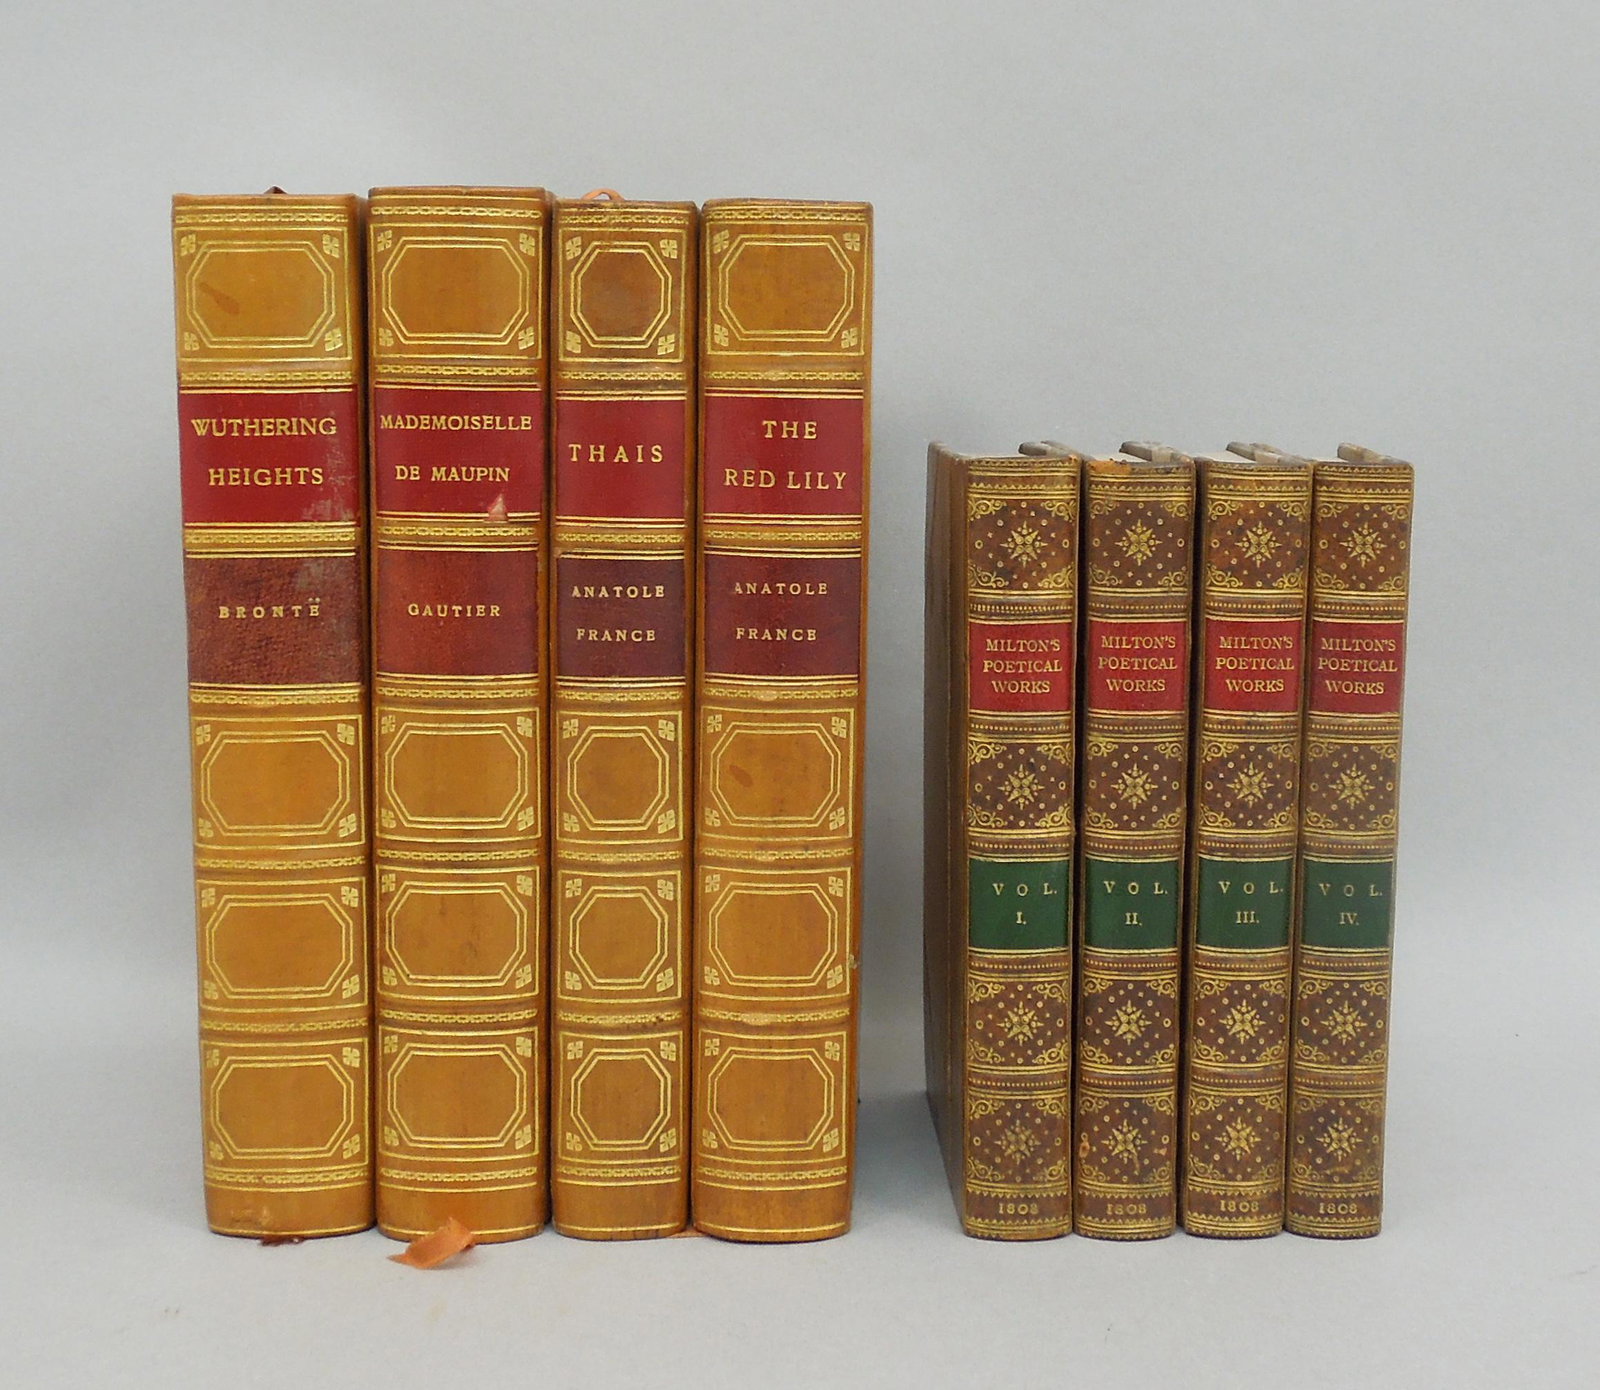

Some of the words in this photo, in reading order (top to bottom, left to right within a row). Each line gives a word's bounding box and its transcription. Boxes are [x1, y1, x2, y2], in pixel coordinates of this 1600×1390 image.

[190, 417, 338, 437] WUTHERING
[380, 414, 533, 431] MADEMOISELLE
[761, 420, 818, 440] THE
[568, 443, 664, 463] THAIS
[208, 467, 324, 486] HEIGHTS
[395, 465, 420, 481] DE
[431, 466, 510, 482] MAUPIN
[723, 468, 776, 488] RED
[786, 471, 847, 490] LILY
[572, 585, 665, 598] ANATOLE
[735, 582, 828, 595] ANATOLE
[218, 597, 321, 619] BRONTË
[407, 603, 501, 618] GAUTIER
[576, 628, 656, 642] FRANCE
[736, 627, 817, 641] FRANCE
[986, 638, 1061, 652] MILTON'S
[1101, 635, 1176, 650] MILTON'S
[1219, 635, 1293, 649] MILTON'S
[1321, 638, 1396, 652] MILTON'S
[983, 658, 1063, 674] POETICAL
[1098, 656, 1177, 671] POETICAL
[1215, 656, 1294, 671] POETICAL
[1318, 657, 1398, 673] POETICAL
[991, 680, 1051, 694] WORKS
[1106, 678, 1166, 692] WORKS
[1226, 679, 1284, 693] WORKS
[1325, 680, 1384, 695] WORKS
